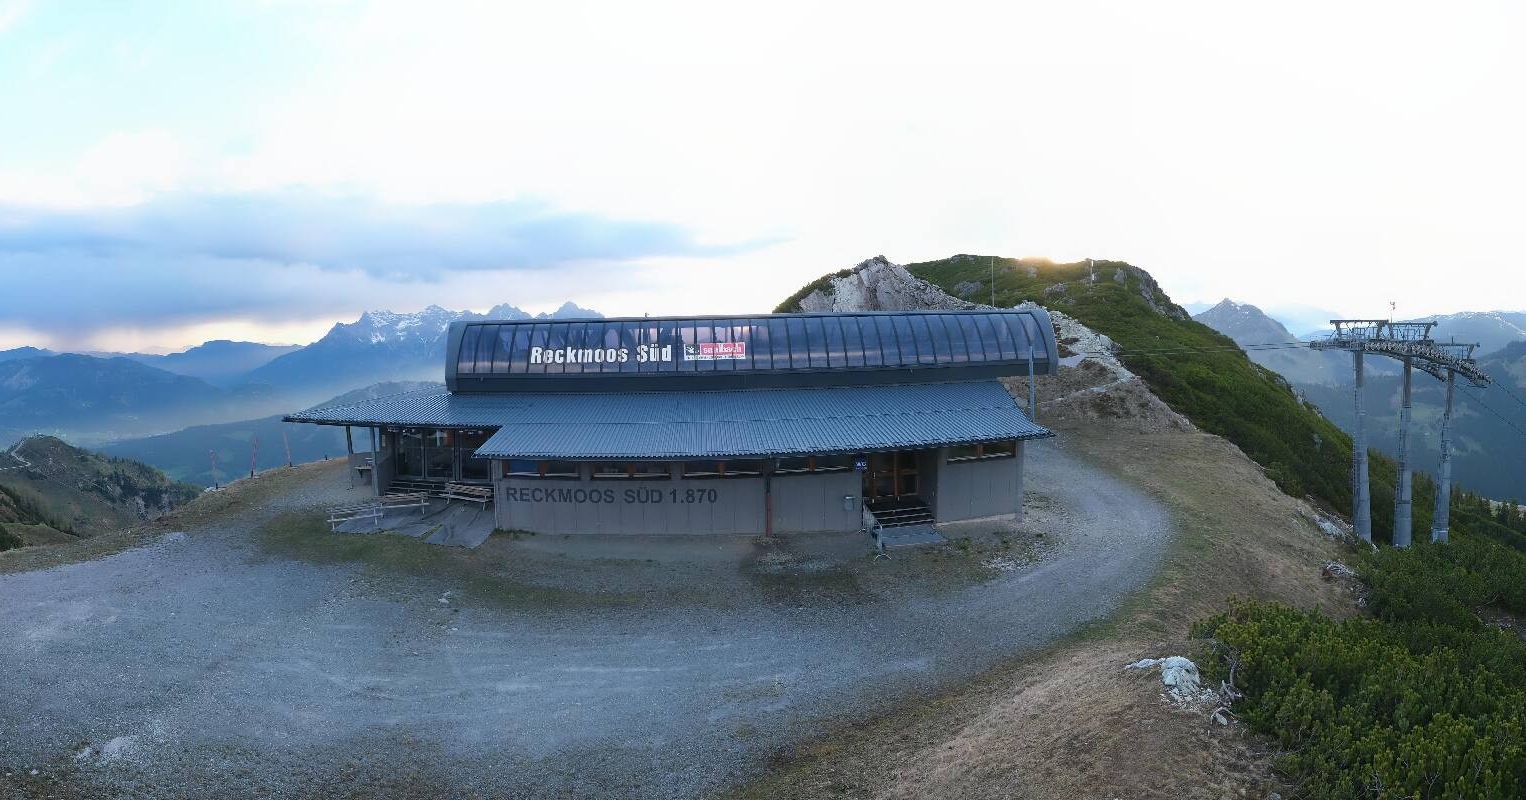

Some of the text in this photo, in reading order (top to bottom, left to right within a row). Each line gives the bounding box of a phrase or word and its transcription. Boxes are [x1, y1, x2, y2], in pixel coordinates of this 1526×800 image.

[530, 344, 672, 363] Reckmoos Süd
[506, 486, 718, 504] RECKMOOS SÜD 1.870
